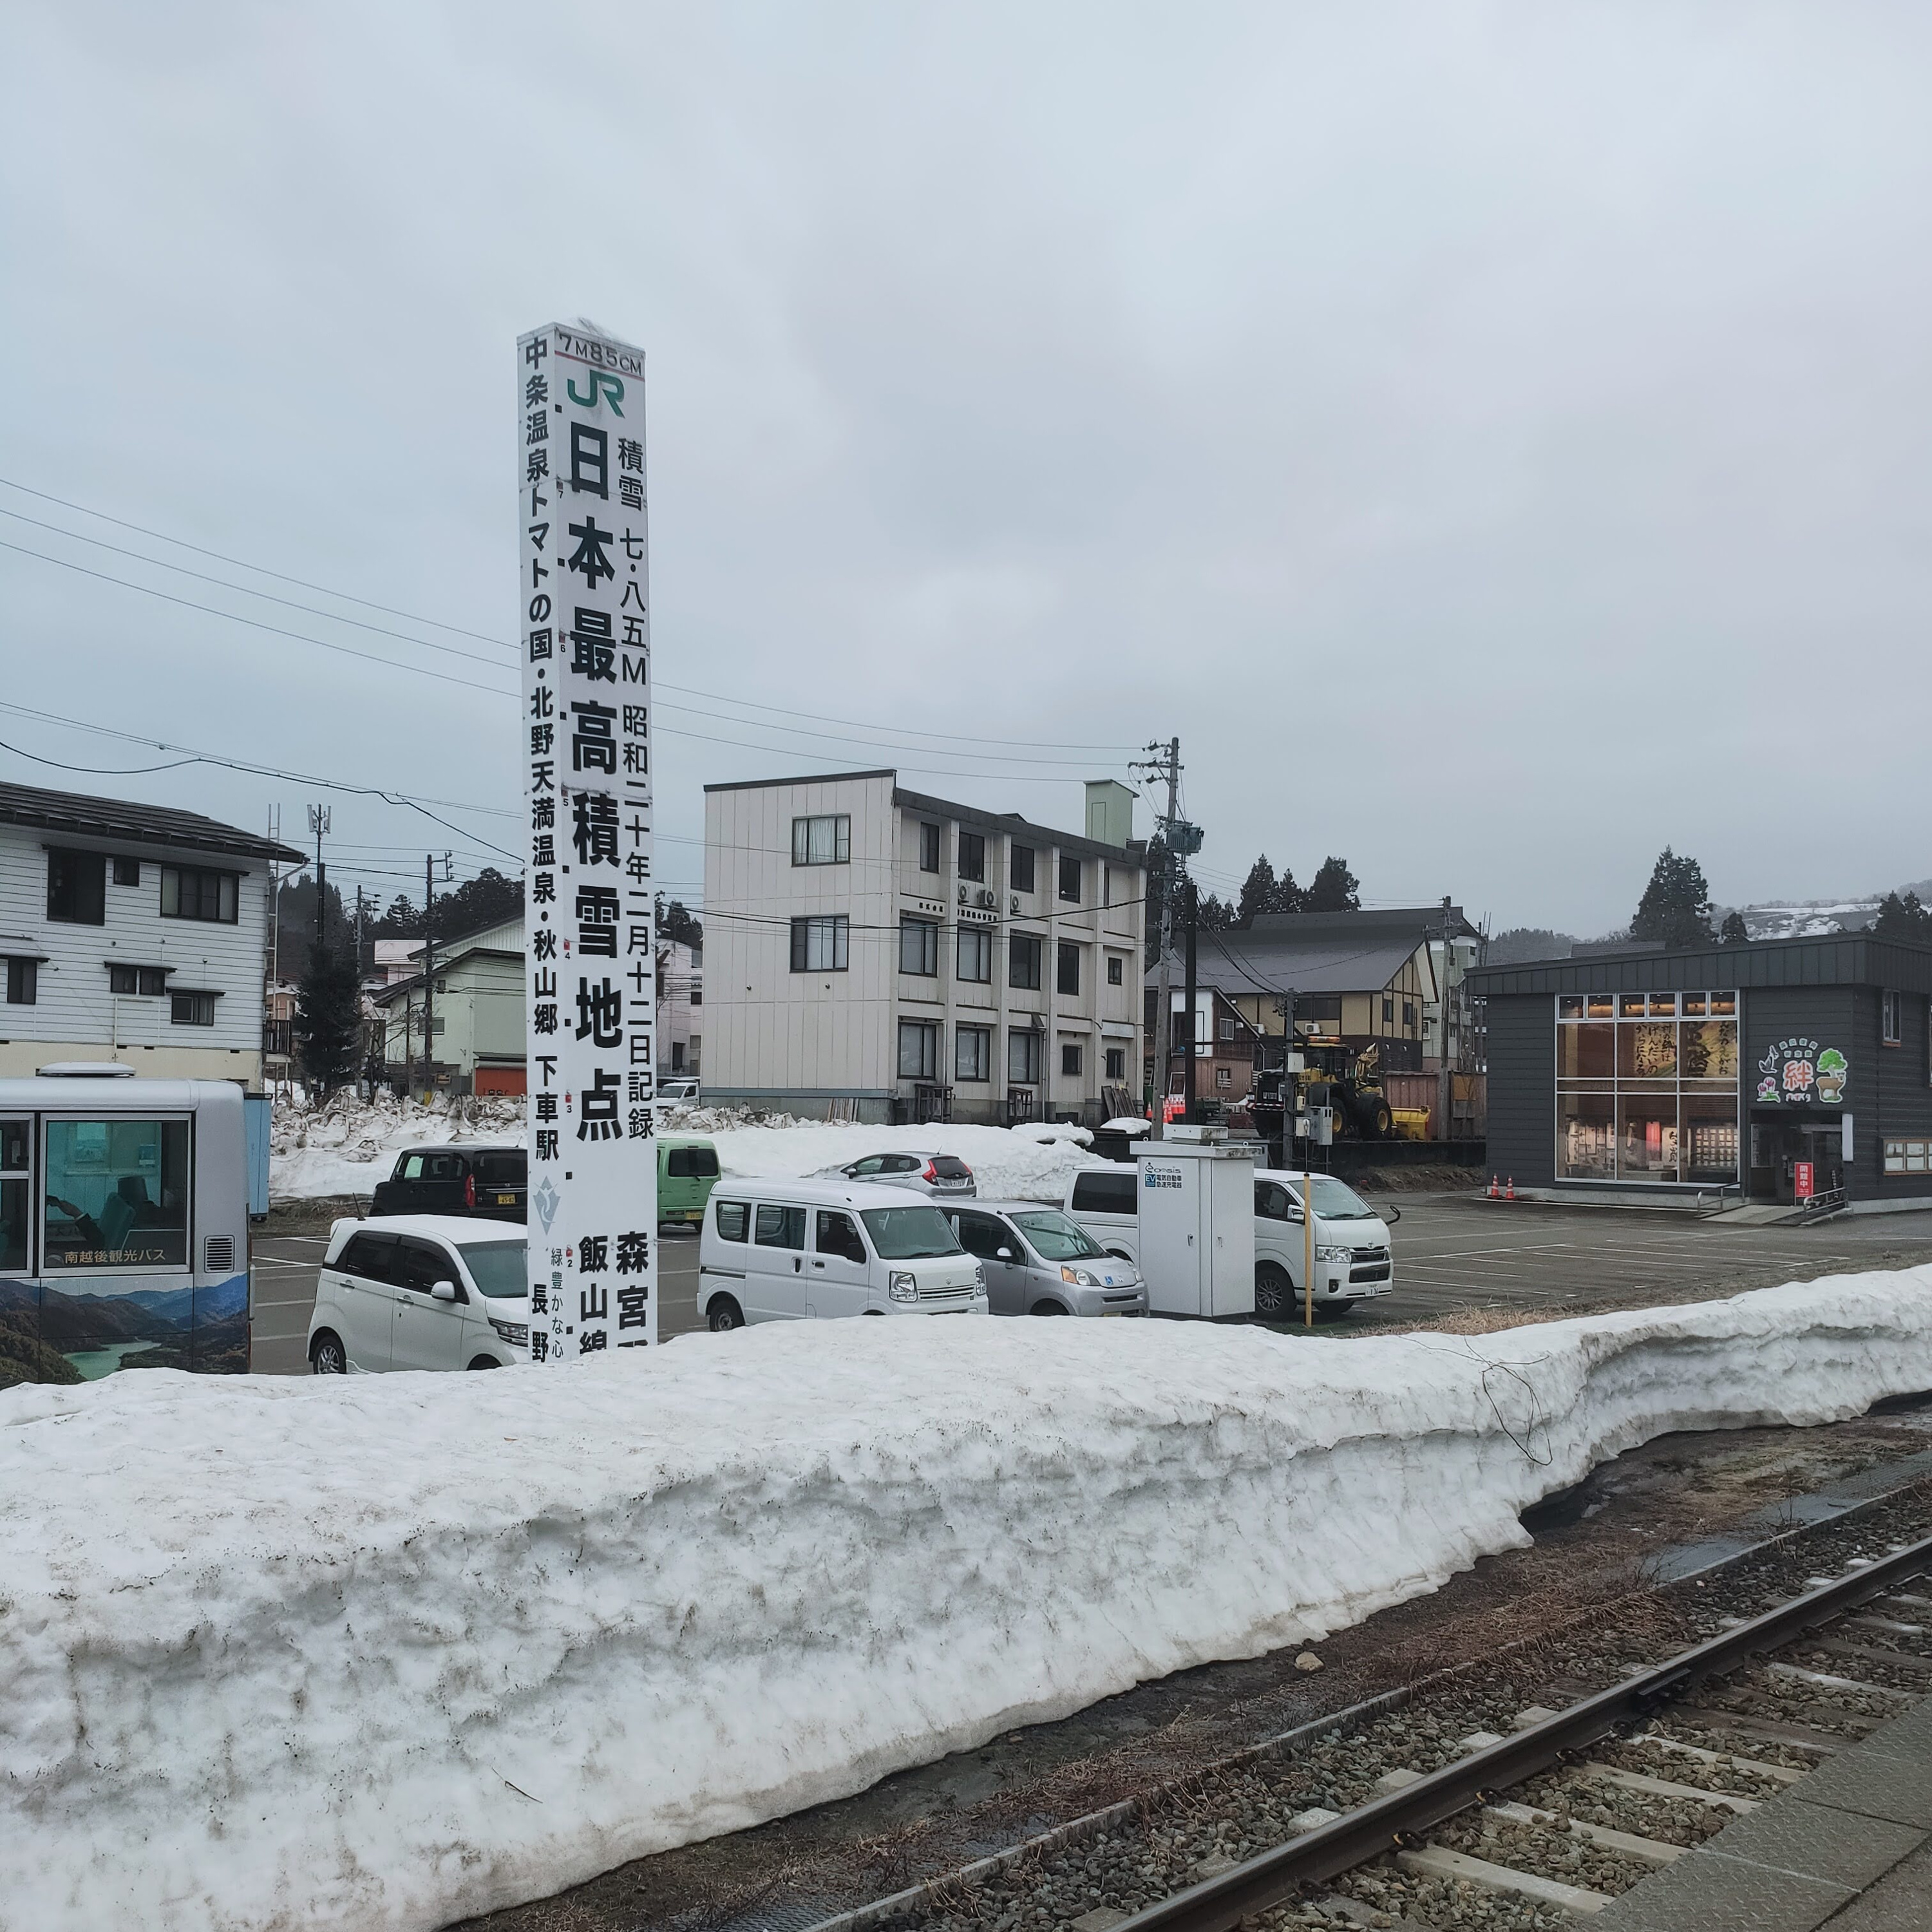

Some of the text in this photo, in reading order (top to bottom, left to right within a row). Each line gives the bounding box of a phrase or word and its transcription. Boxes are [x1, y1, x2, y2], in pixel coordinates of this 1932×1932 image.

[558, 334, 642, 376] 7M85CM
[567, 370, 625, 419] JR
[618, 438, 643, 511] 積雪
[567, 421, 623, 1142] 日本最高積雪地点
[623, 704, 654, 1140] 昭和二十年二月十二日記録
[535, 1056, 560, 1160] 下車駅
[1784, 1061, 1813, 1090] 絆
[64, 1249, 166, 1264] 南越後観光バス
[567, 1259, 573, 1267] 2
[616, 1231, 649, 1347] 森宮
[531, 1283, 549, 1363] 長野
[551, 1247, 564, 1358] 緑豊かな心
